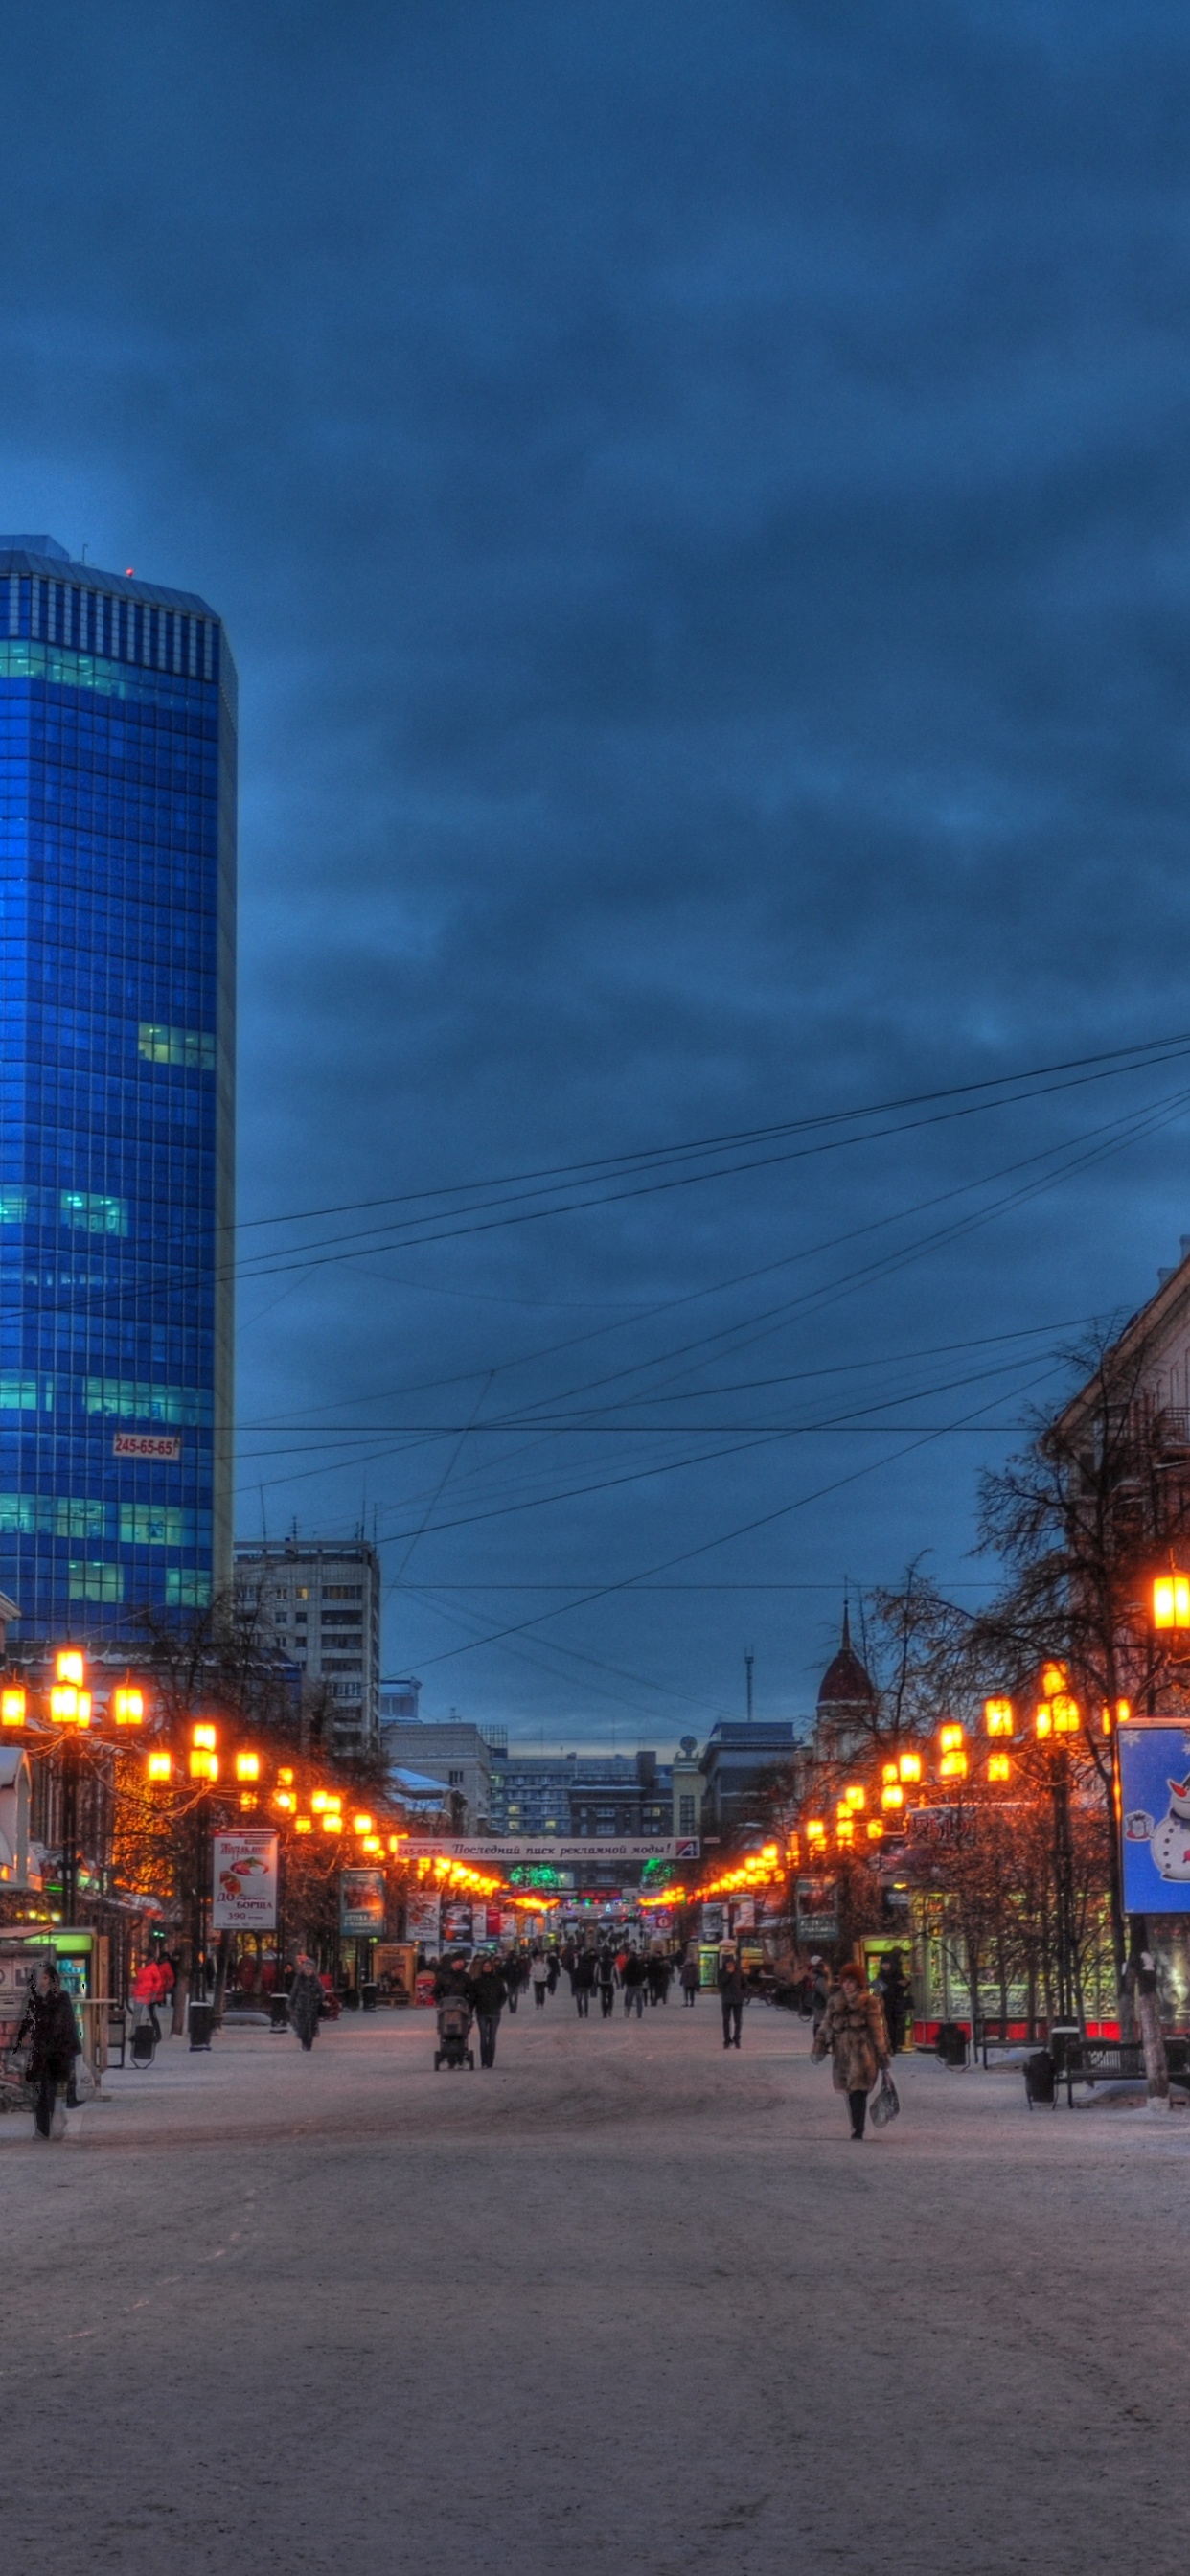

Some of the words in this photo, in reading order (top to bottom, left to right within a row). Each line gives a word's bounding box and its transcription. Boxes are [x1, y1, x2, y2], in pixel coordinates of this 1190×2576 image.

[115, 1438, 172, 1455] 245-65-65
[398, 1848, 443, 1856] 245-65-65
[452, 1843, 520, 1854] Последний
[526, 1846, 555, 1854] писк
[560, 1845, 627, 1857] рекламной
[630, 1843, 672, 1854] моды!
[236, 1901, 272, 1910] БОРЩА
